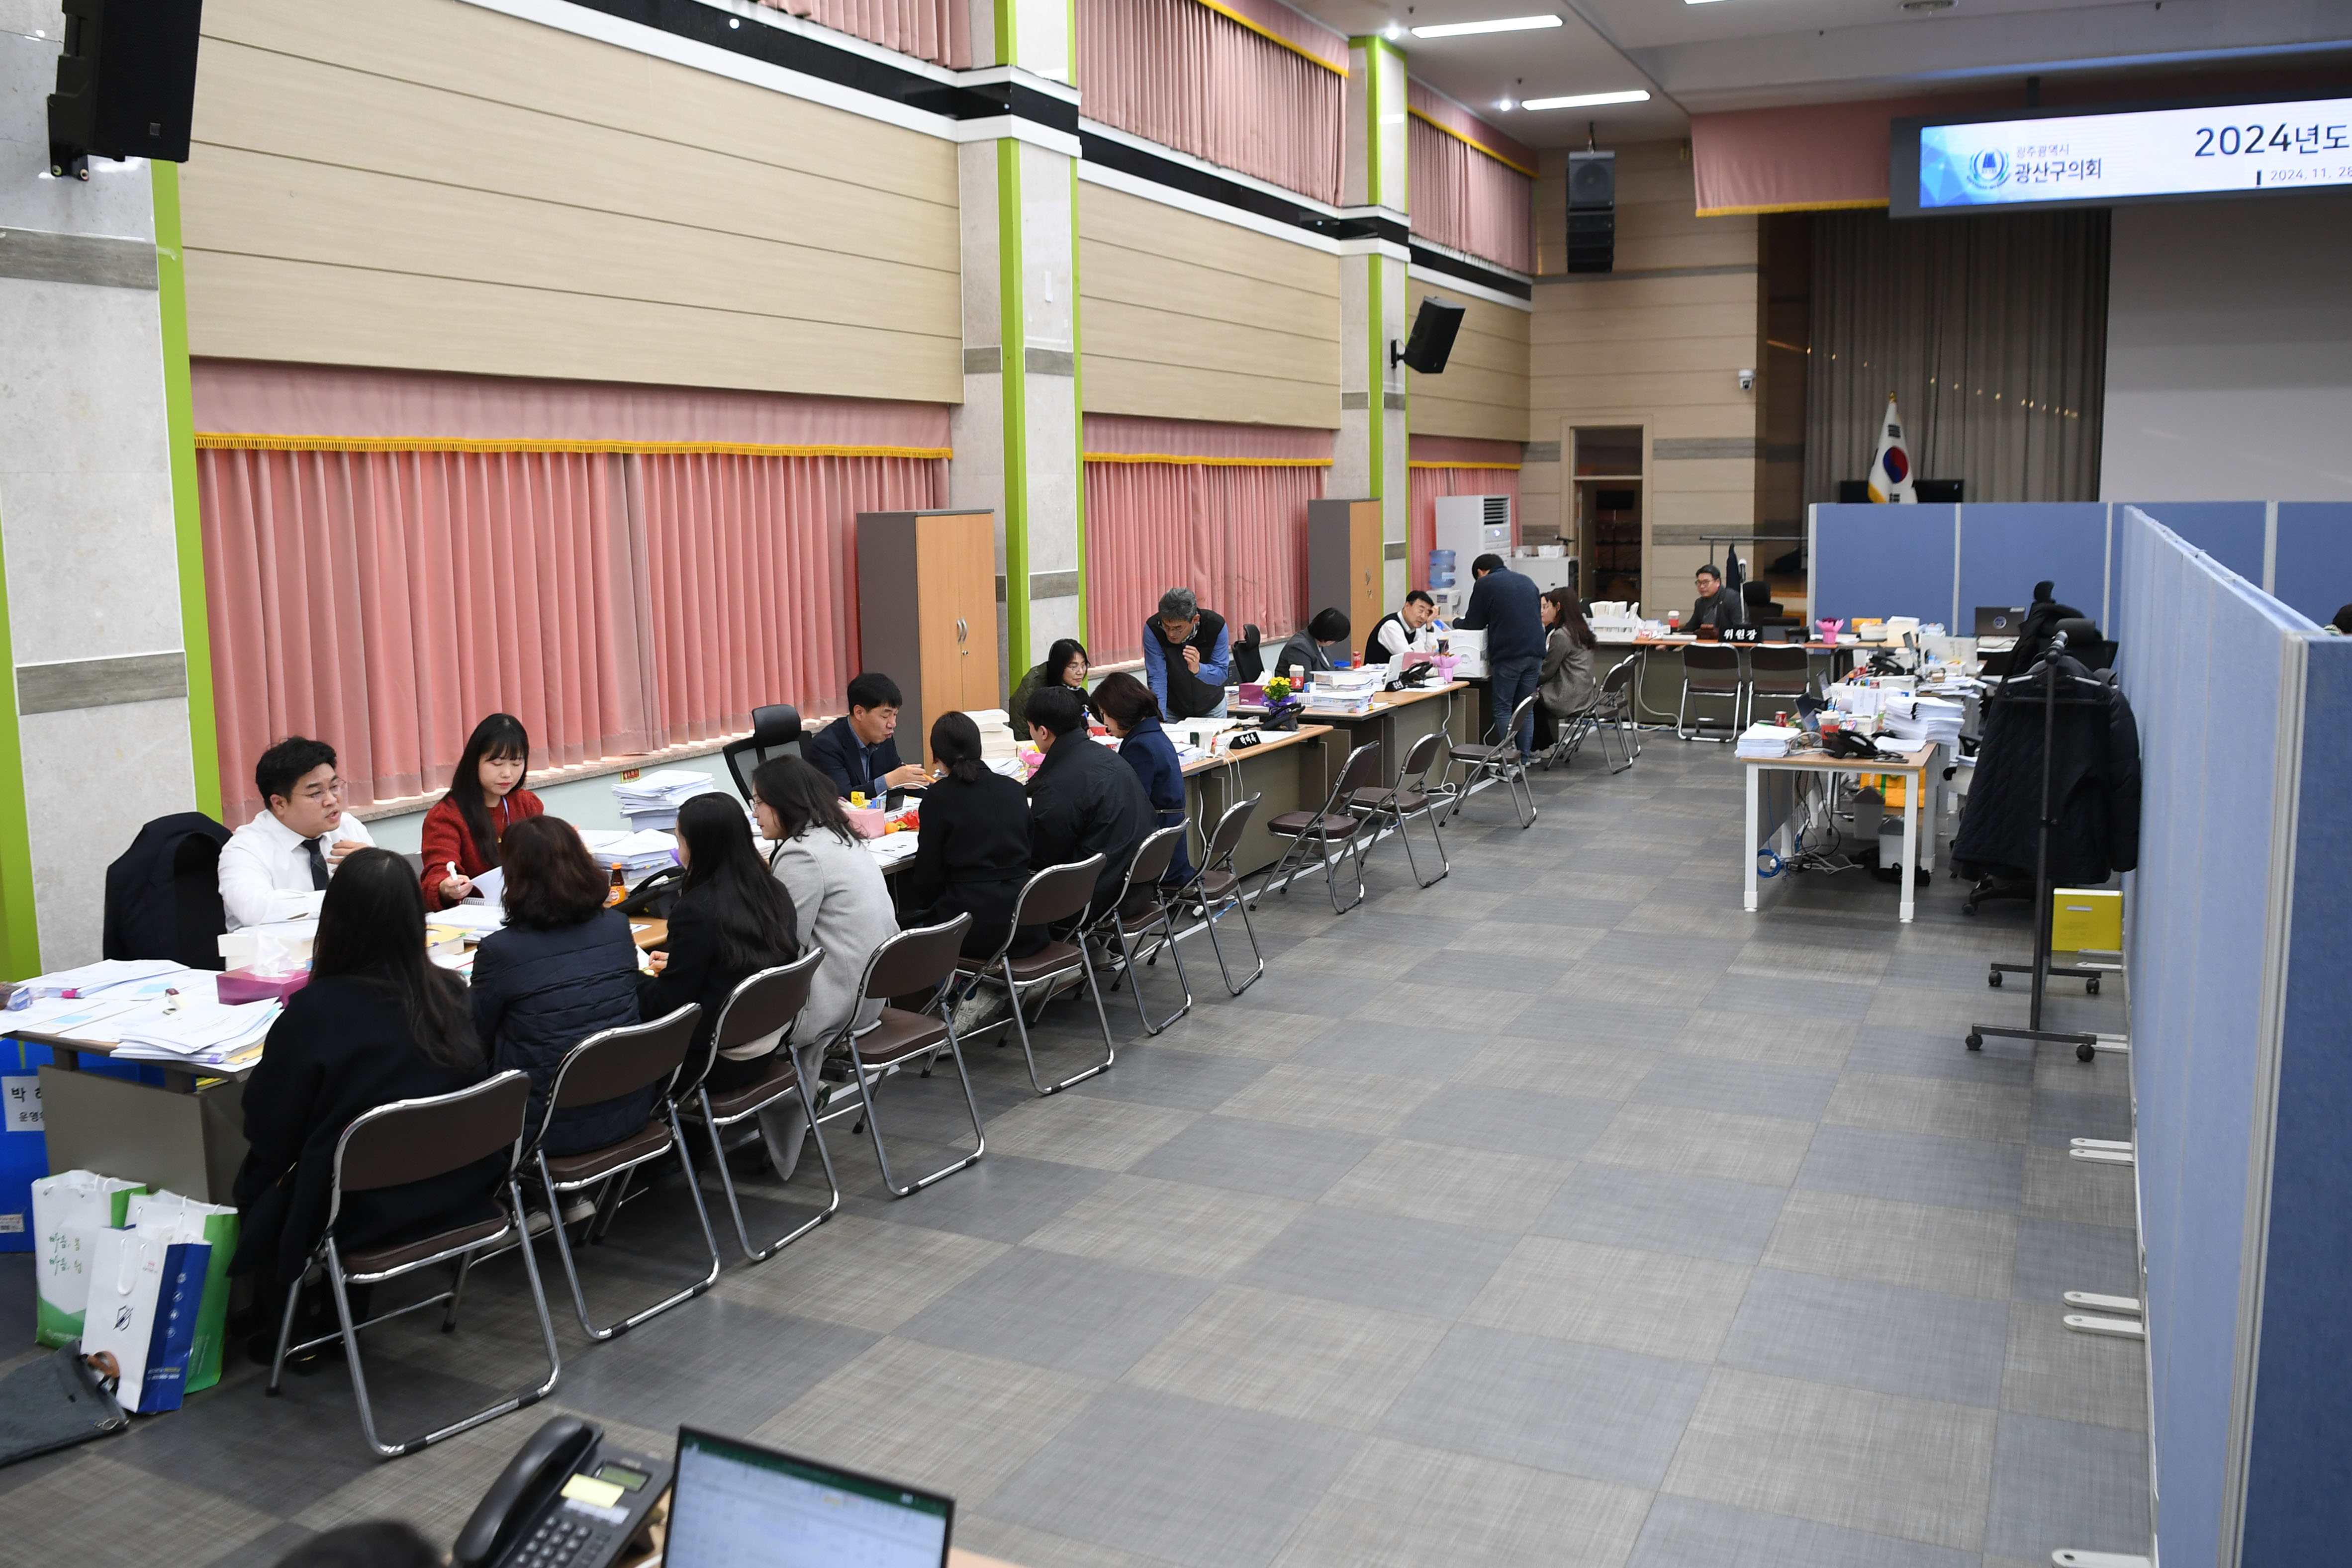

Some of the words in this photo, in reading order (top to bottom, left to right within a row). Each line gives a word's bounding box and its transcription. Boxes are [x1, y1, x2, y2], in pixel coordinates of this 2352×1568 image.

[2194, 122, 2350, 157] 2024년도
[2016, 143, 2070, 159] 광주광역시
[2014, 157, 2102, 184] 광산구의회
[1723, 628, 1758, 641] 위원장
